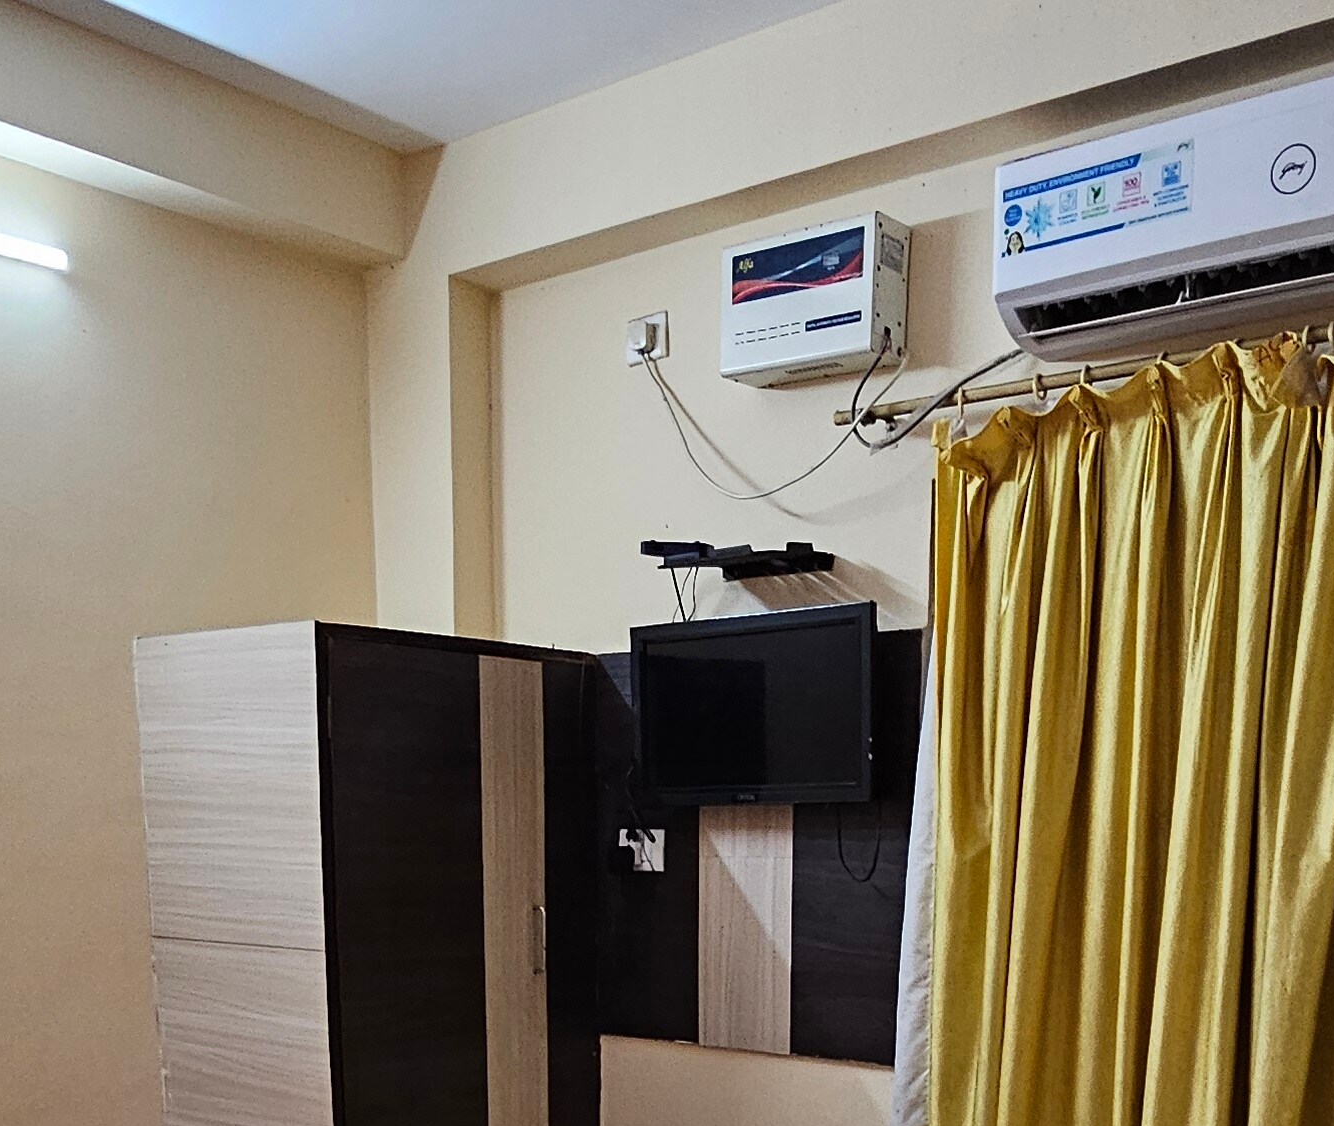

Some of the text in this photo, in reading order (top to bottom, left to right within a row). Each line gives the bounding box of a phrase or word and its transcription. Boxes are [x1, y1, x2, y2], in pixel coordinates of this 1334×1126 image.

[1004, 187, 1028, 199] HEAVY
[1049, 167, 1098, 187] ENVIRONMENT
[1099, 158, 1135, 175] FRIENDLY
